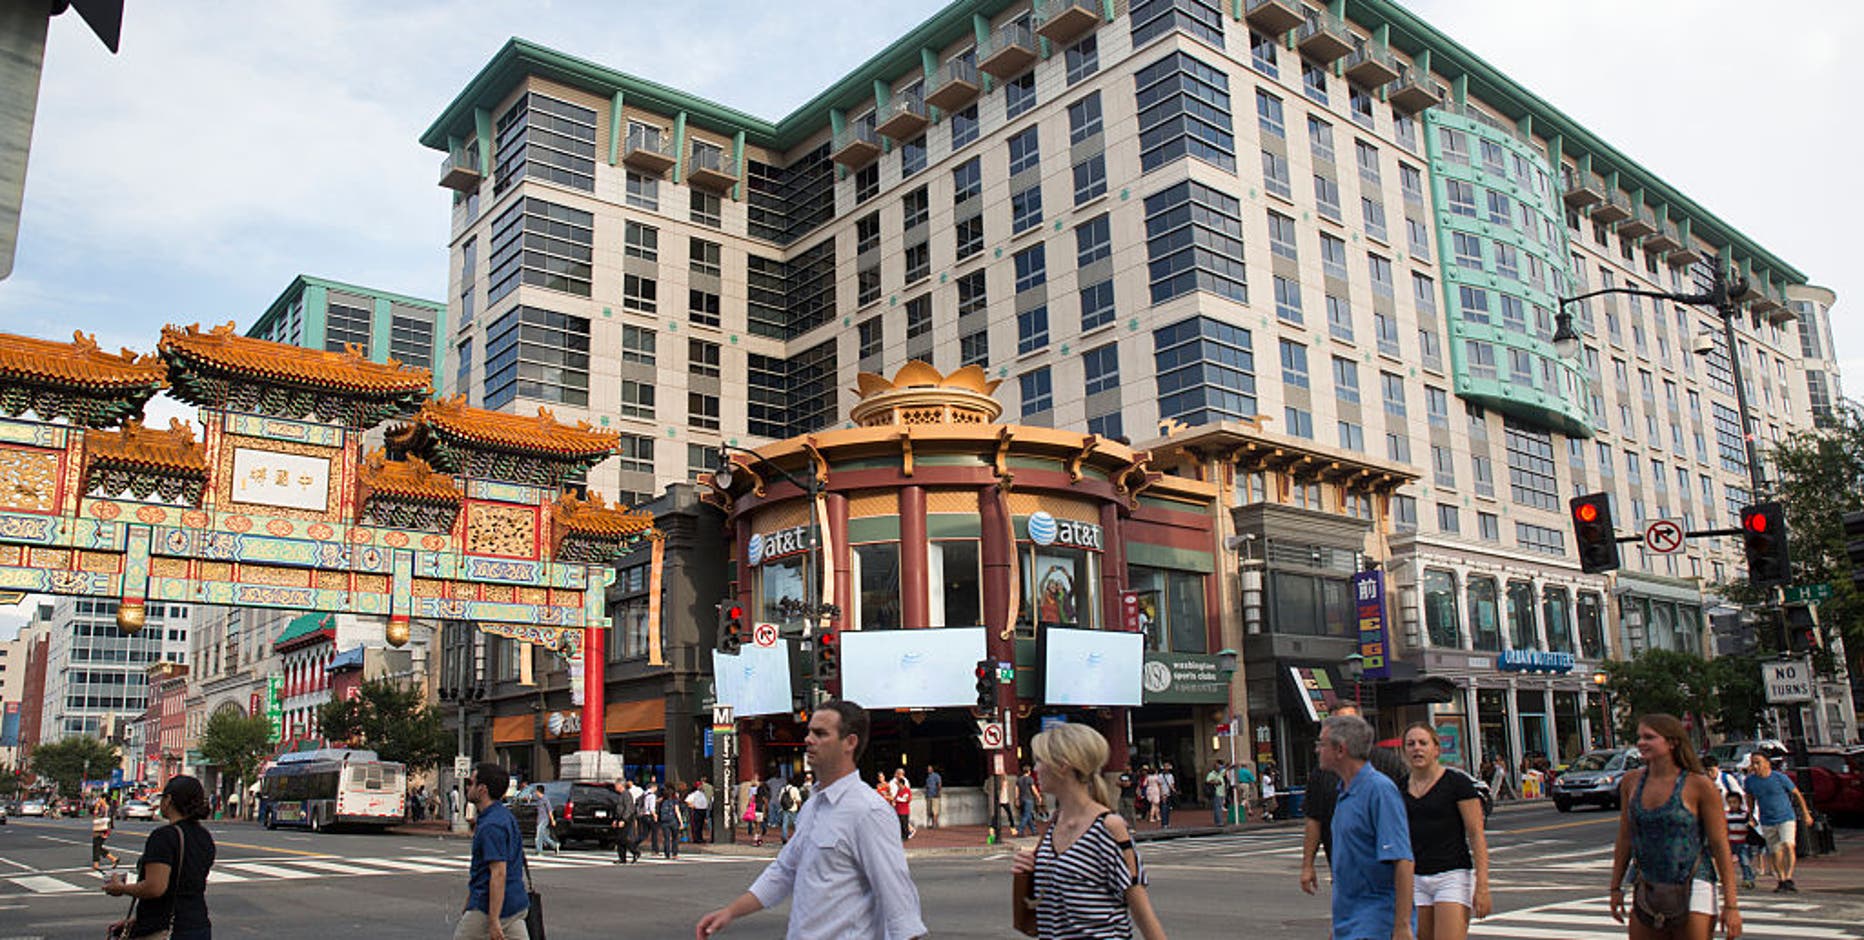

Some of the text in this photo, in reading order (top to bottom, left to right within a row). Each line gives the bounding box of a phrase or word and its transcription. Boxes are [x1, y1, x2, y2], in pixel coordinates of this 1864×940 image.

[1060, 521, 1099, 547] at&t
[764, 526, 805, 557] at&t
[1358, 579, 1377, 600] 前
[1801, 587, 1810, 598] H
[1173, 660, 1216, 671] washington
[1776, 667, 1795, 680] NO
[1771, 684, 1808, 696] TURNS
[714, 708, 729, 724] M
